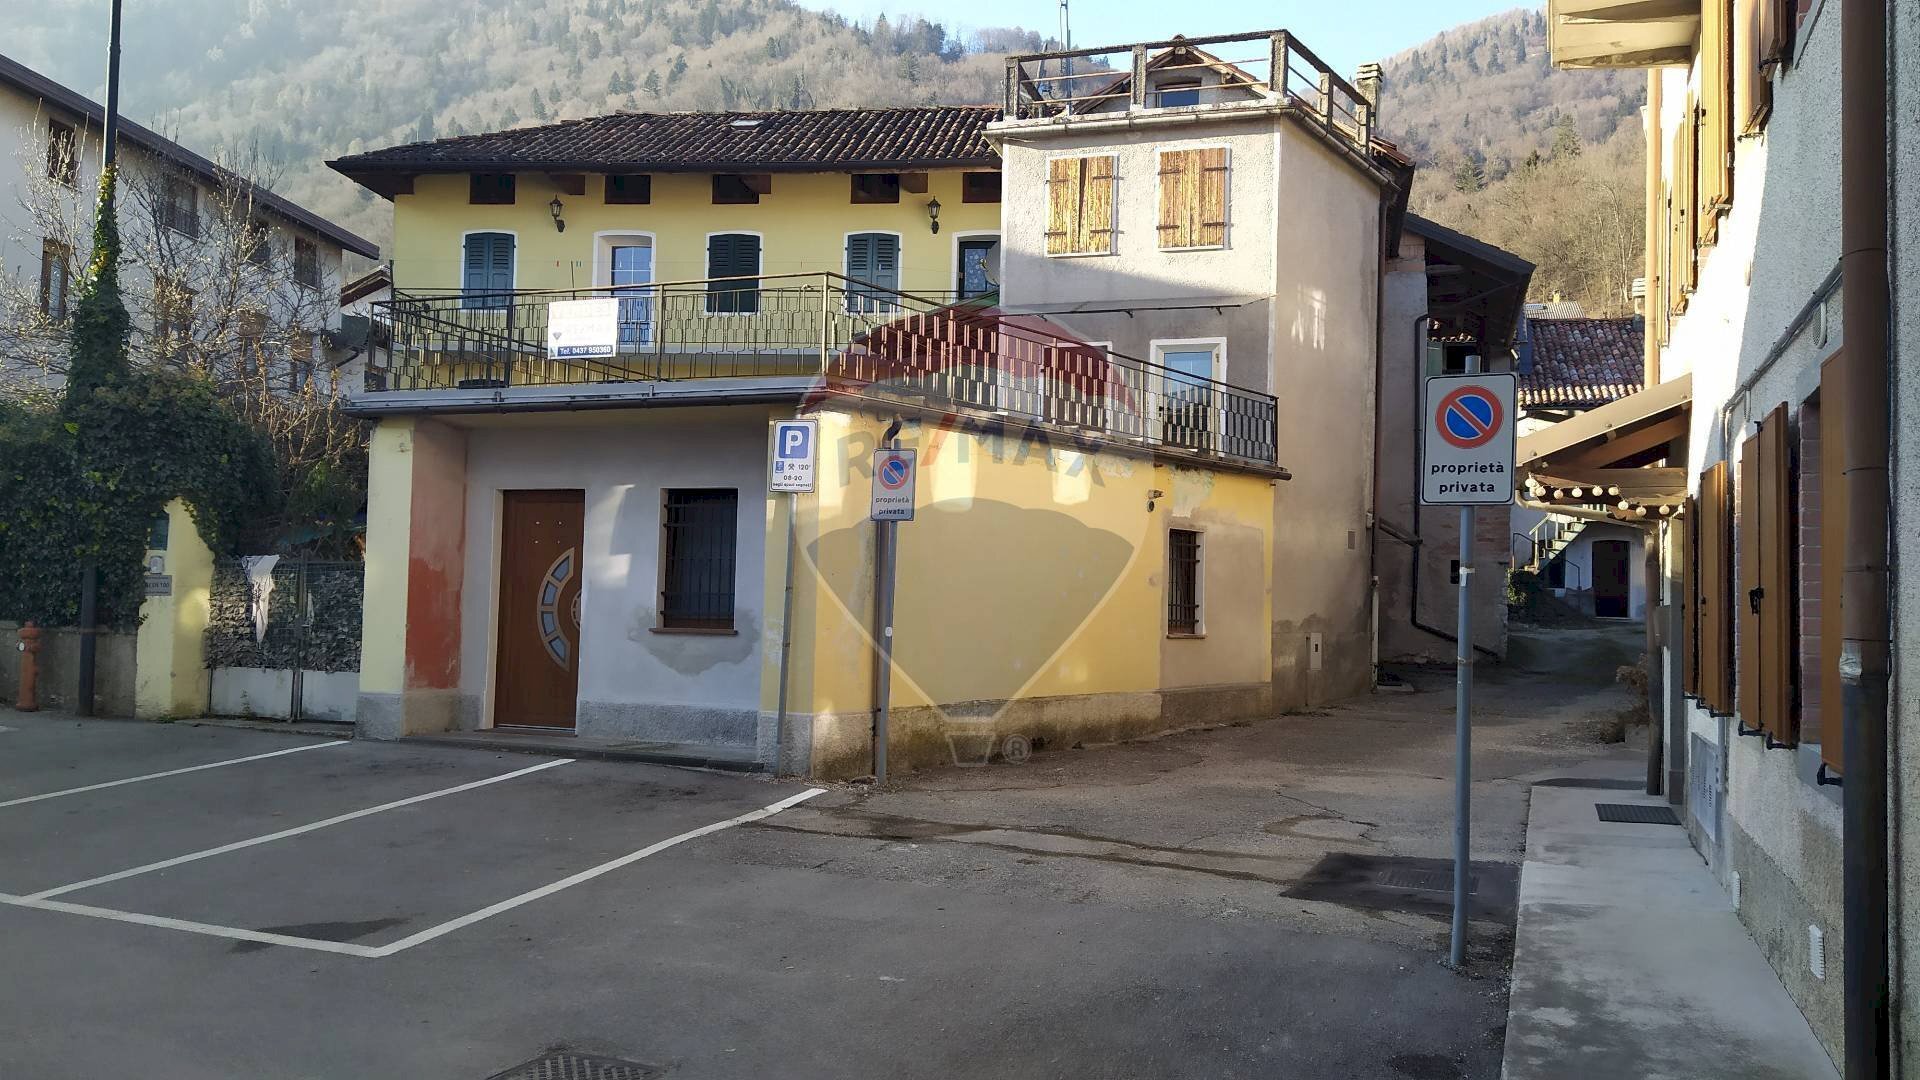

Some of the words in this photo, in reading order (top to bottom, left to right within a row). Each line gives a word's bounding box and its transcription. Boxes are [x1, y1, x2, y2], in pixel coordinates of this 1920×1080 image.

[572, 346, 587, 354] 0437
[785, 430, 803, 454] P
[1431, 461, 1504, 475] proprietà
[1439, 481, 1495, 494] privata
[875, 495, 910, 504] proprietà
[878, 507, 905, 516] privata
